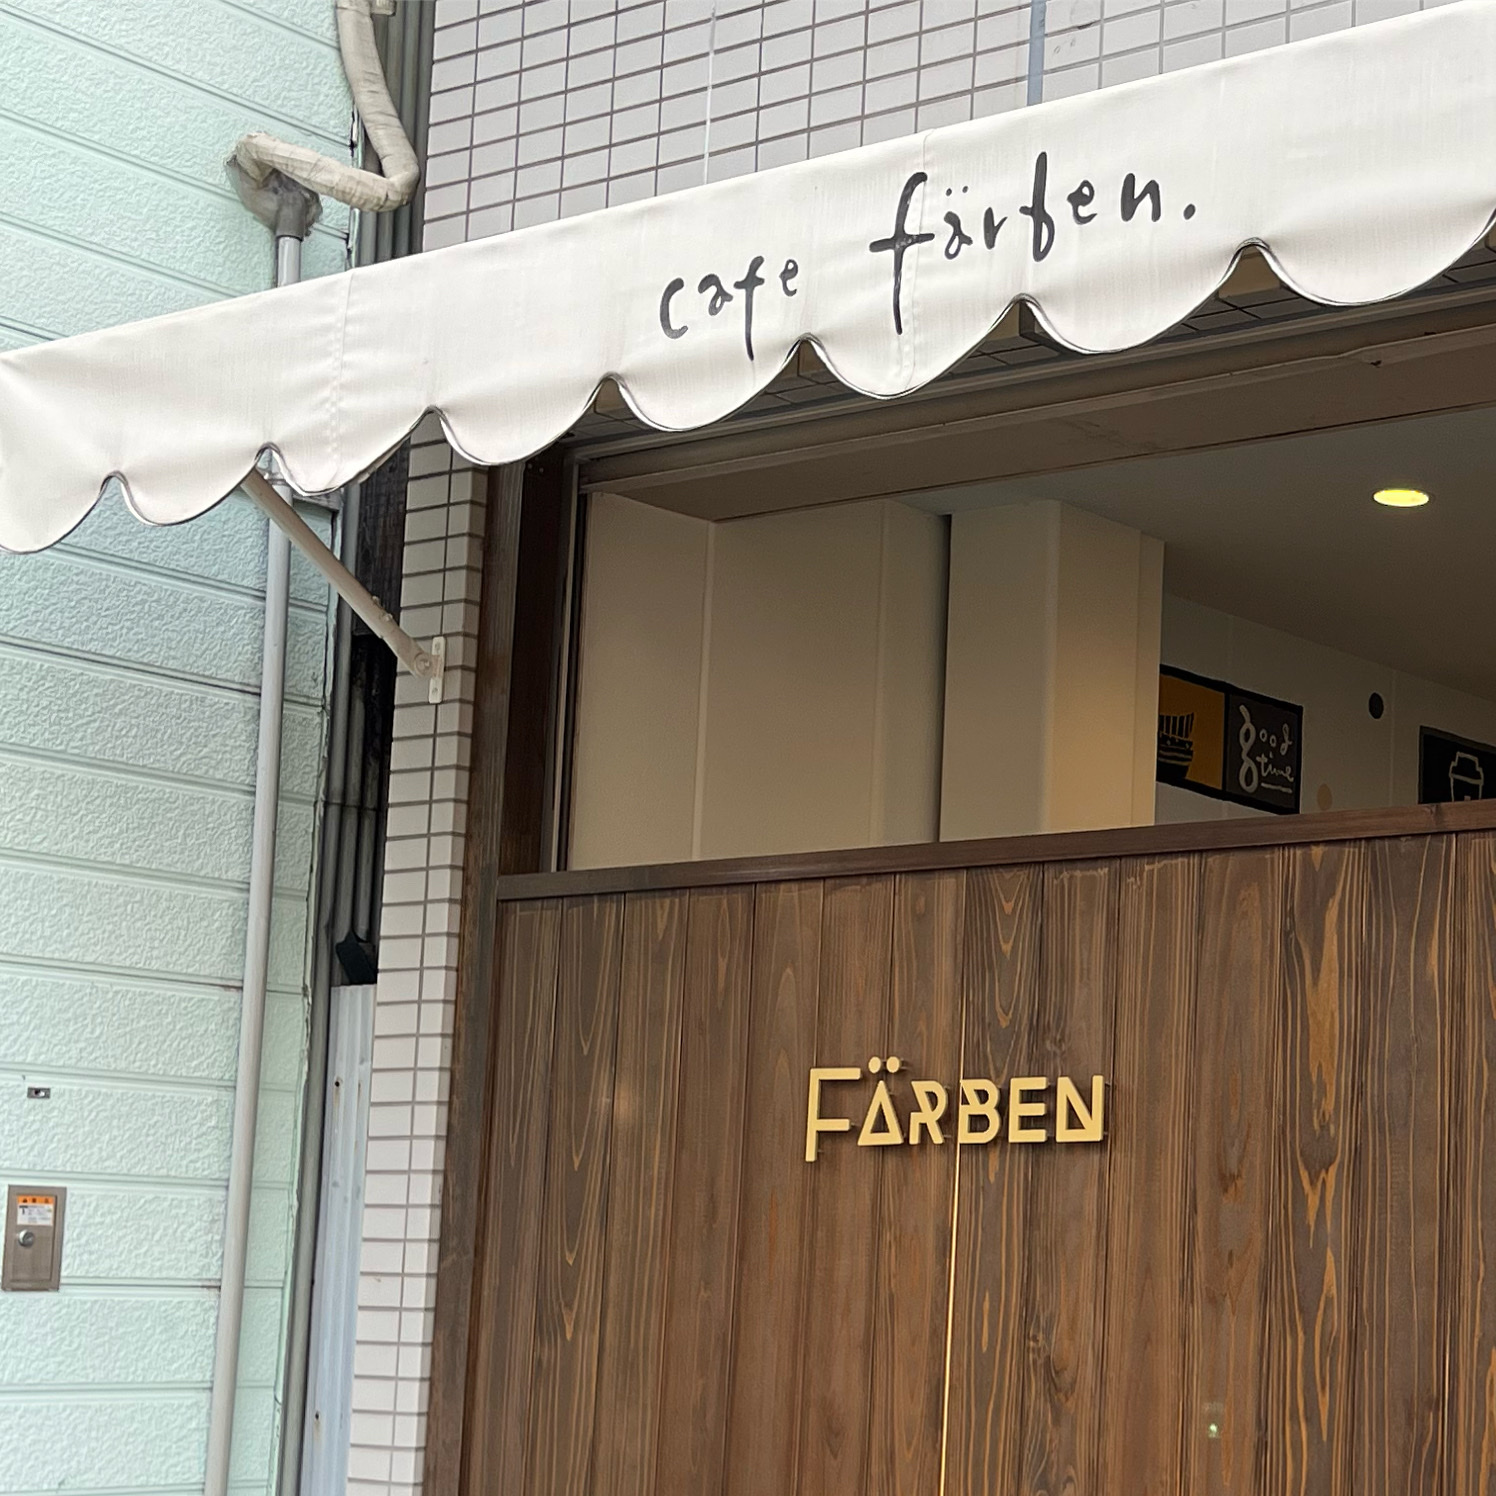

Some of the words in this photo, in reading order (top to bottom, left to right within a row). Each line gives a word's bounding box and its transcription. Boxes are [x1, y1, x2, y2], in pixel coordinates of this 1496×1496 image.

[659, 256, 799, 361] cafe
[1238, 704, 1294, 793] good
[1255, 751, 1295, 783] time
[804, 1056, 1105, 1162] FÄRBEN
